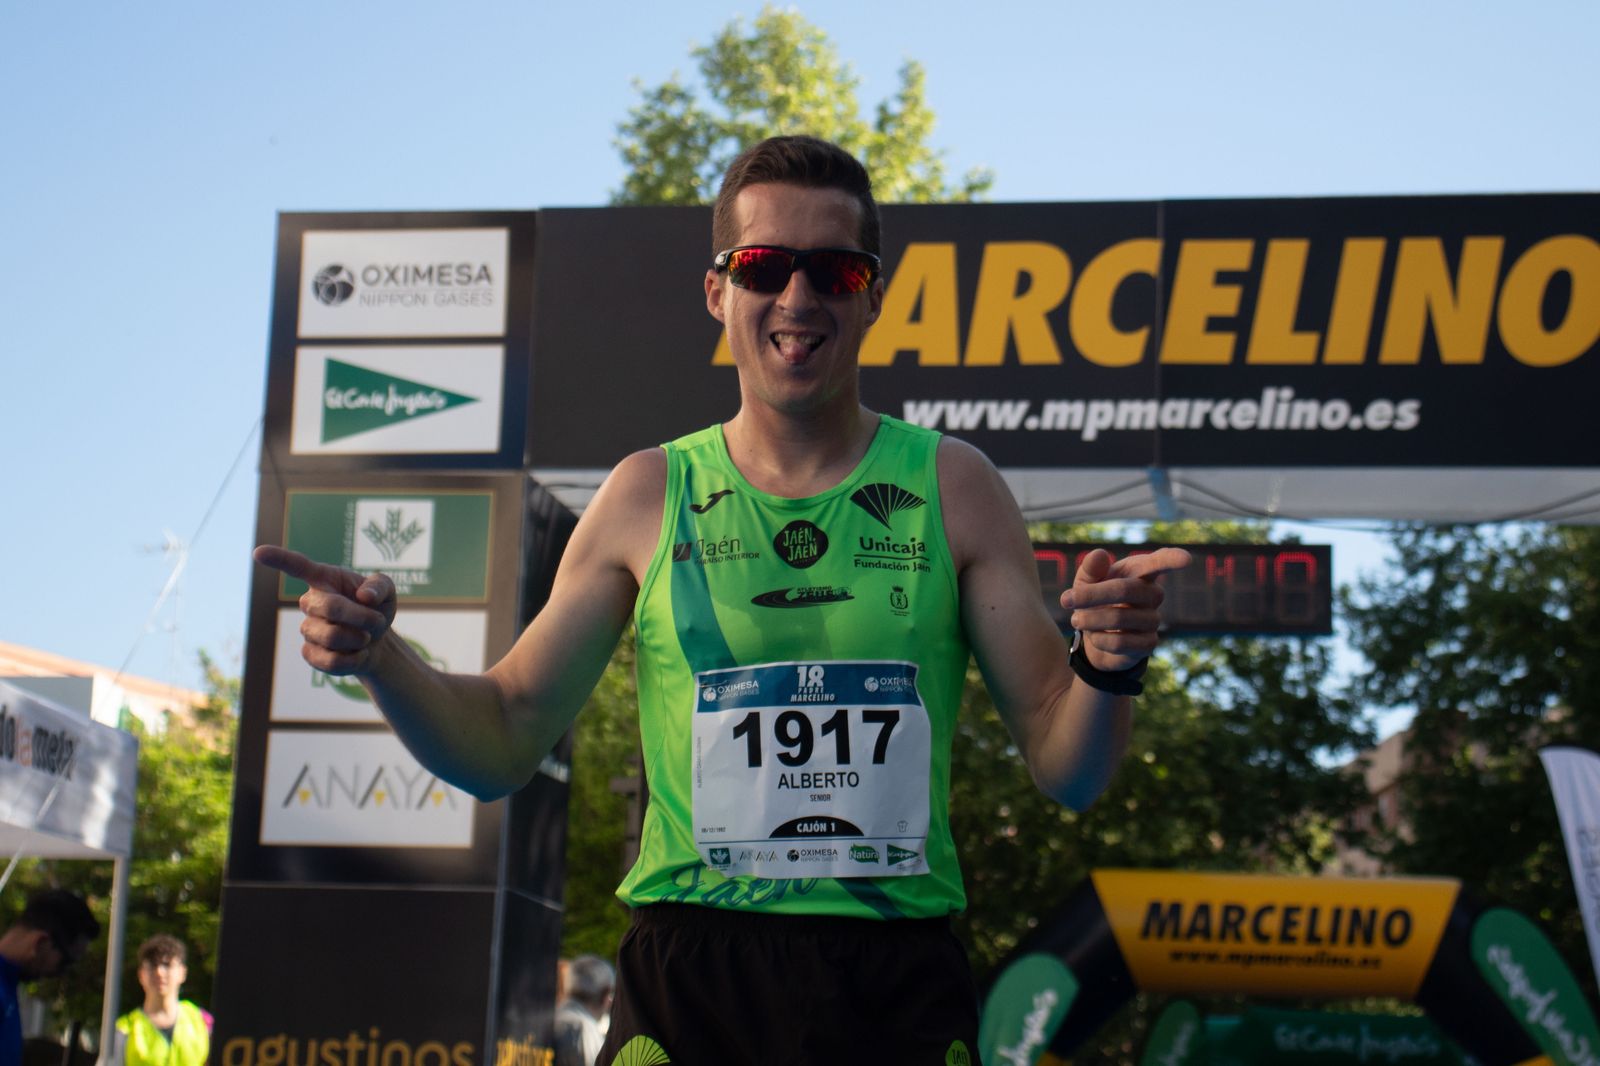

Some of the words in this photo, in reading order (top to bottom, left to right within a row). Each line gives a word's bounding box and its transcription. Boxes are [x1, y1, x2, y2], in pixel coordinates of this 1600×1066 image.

[361, 262, 493, 288] OXIMESA
[359, 290, 427, 308] NIPPON
[711, 233, 1600, 368] ARCELINO
[904, 387, 1420, 441] www.mpmarcelino.es
[859, 536, 926, 556] Unicaja
[724, 552, 760, 561] INTERIOR
[854, 559, 909, 571] Fundación
[797, 665, 825, 687] 18
[717, 680, 759, 694] OXIMESA
[790, 694, 835, 702] MARCELINO
[733, 709, 900, 769] 1917
[282, 763, 457, 810] ANAYA
[778, 771, 860, 790] ALBERTO
[797, 820, 828, 833] CAJÓN
[831, 820, 836, 832] 1
[800, 848, 838, 857] OXIMESA
[1140, 901, 1413, 947] MARCELINO
